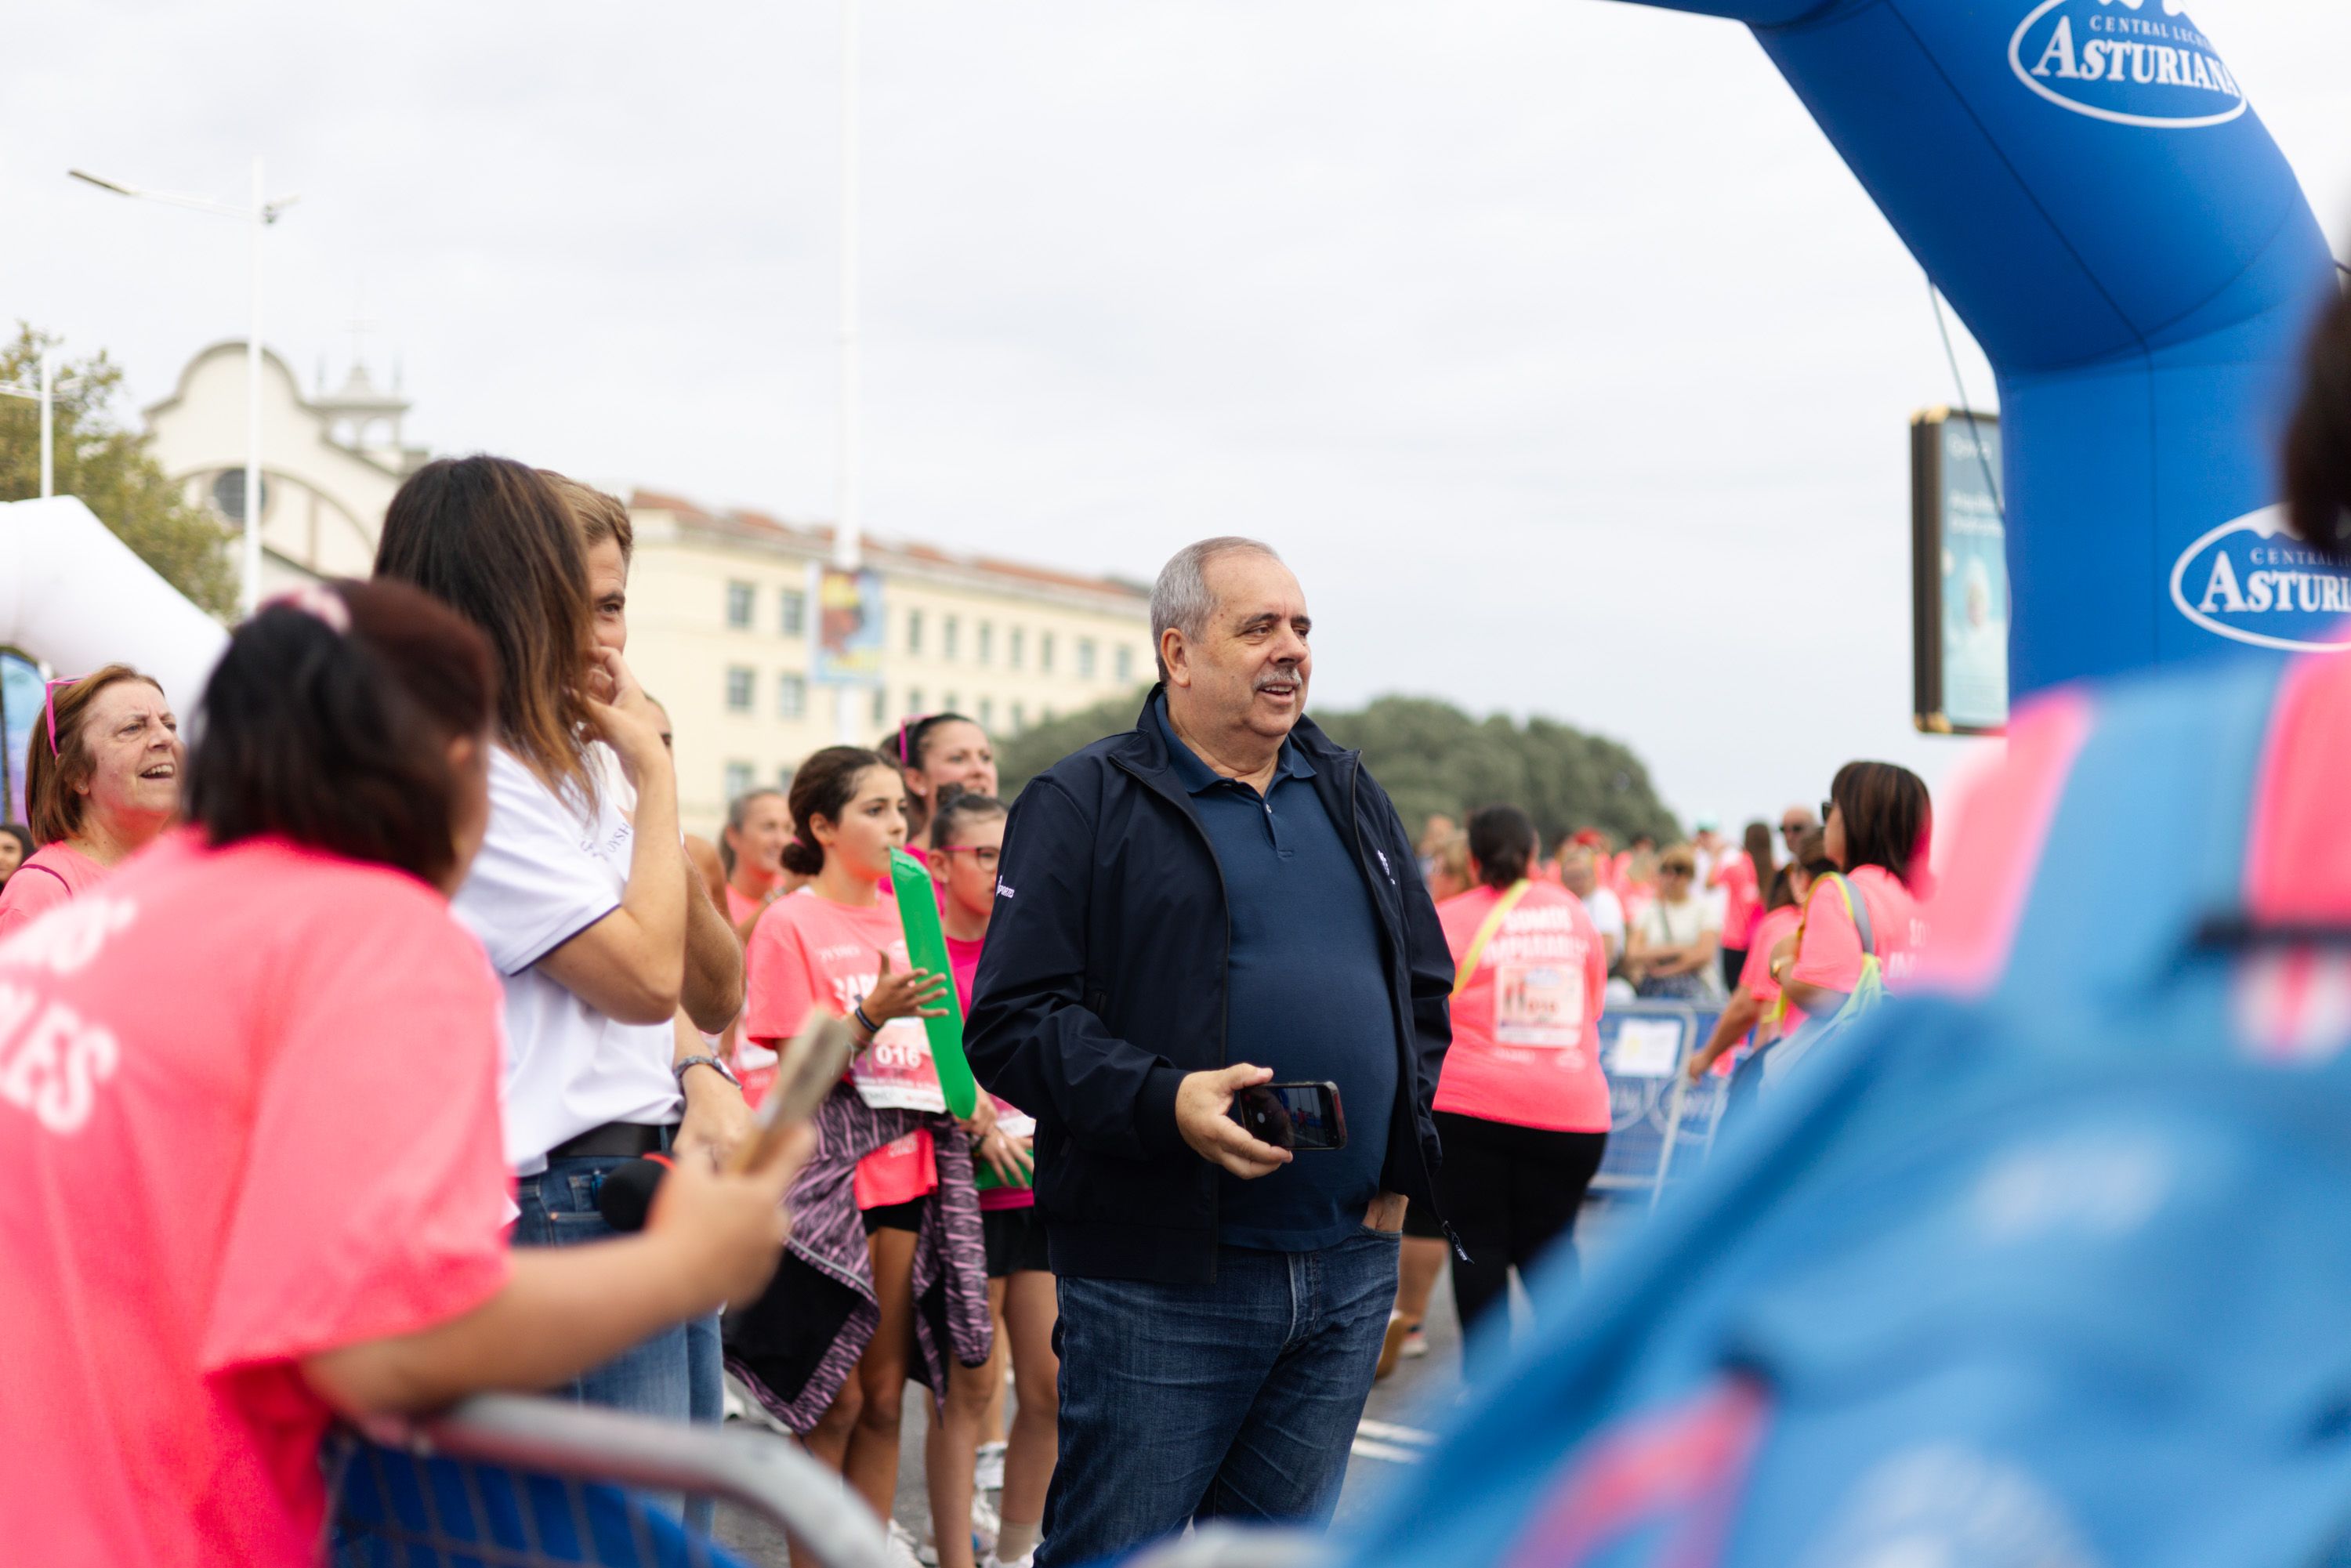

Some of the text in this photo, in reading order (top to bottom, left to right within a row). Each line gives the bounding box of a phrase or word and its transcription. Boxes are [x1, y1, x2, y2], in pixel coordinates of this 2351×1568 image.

[2088, 14, 2169, 38] CENTRAL
[2030, 15, 2241, 99] ASTURIANA
[2249, 547, 2334, 566] CENTRAL
[2197, 550, 2351, 613] ASTURI
[875, 1045, 922, 1069] 016
